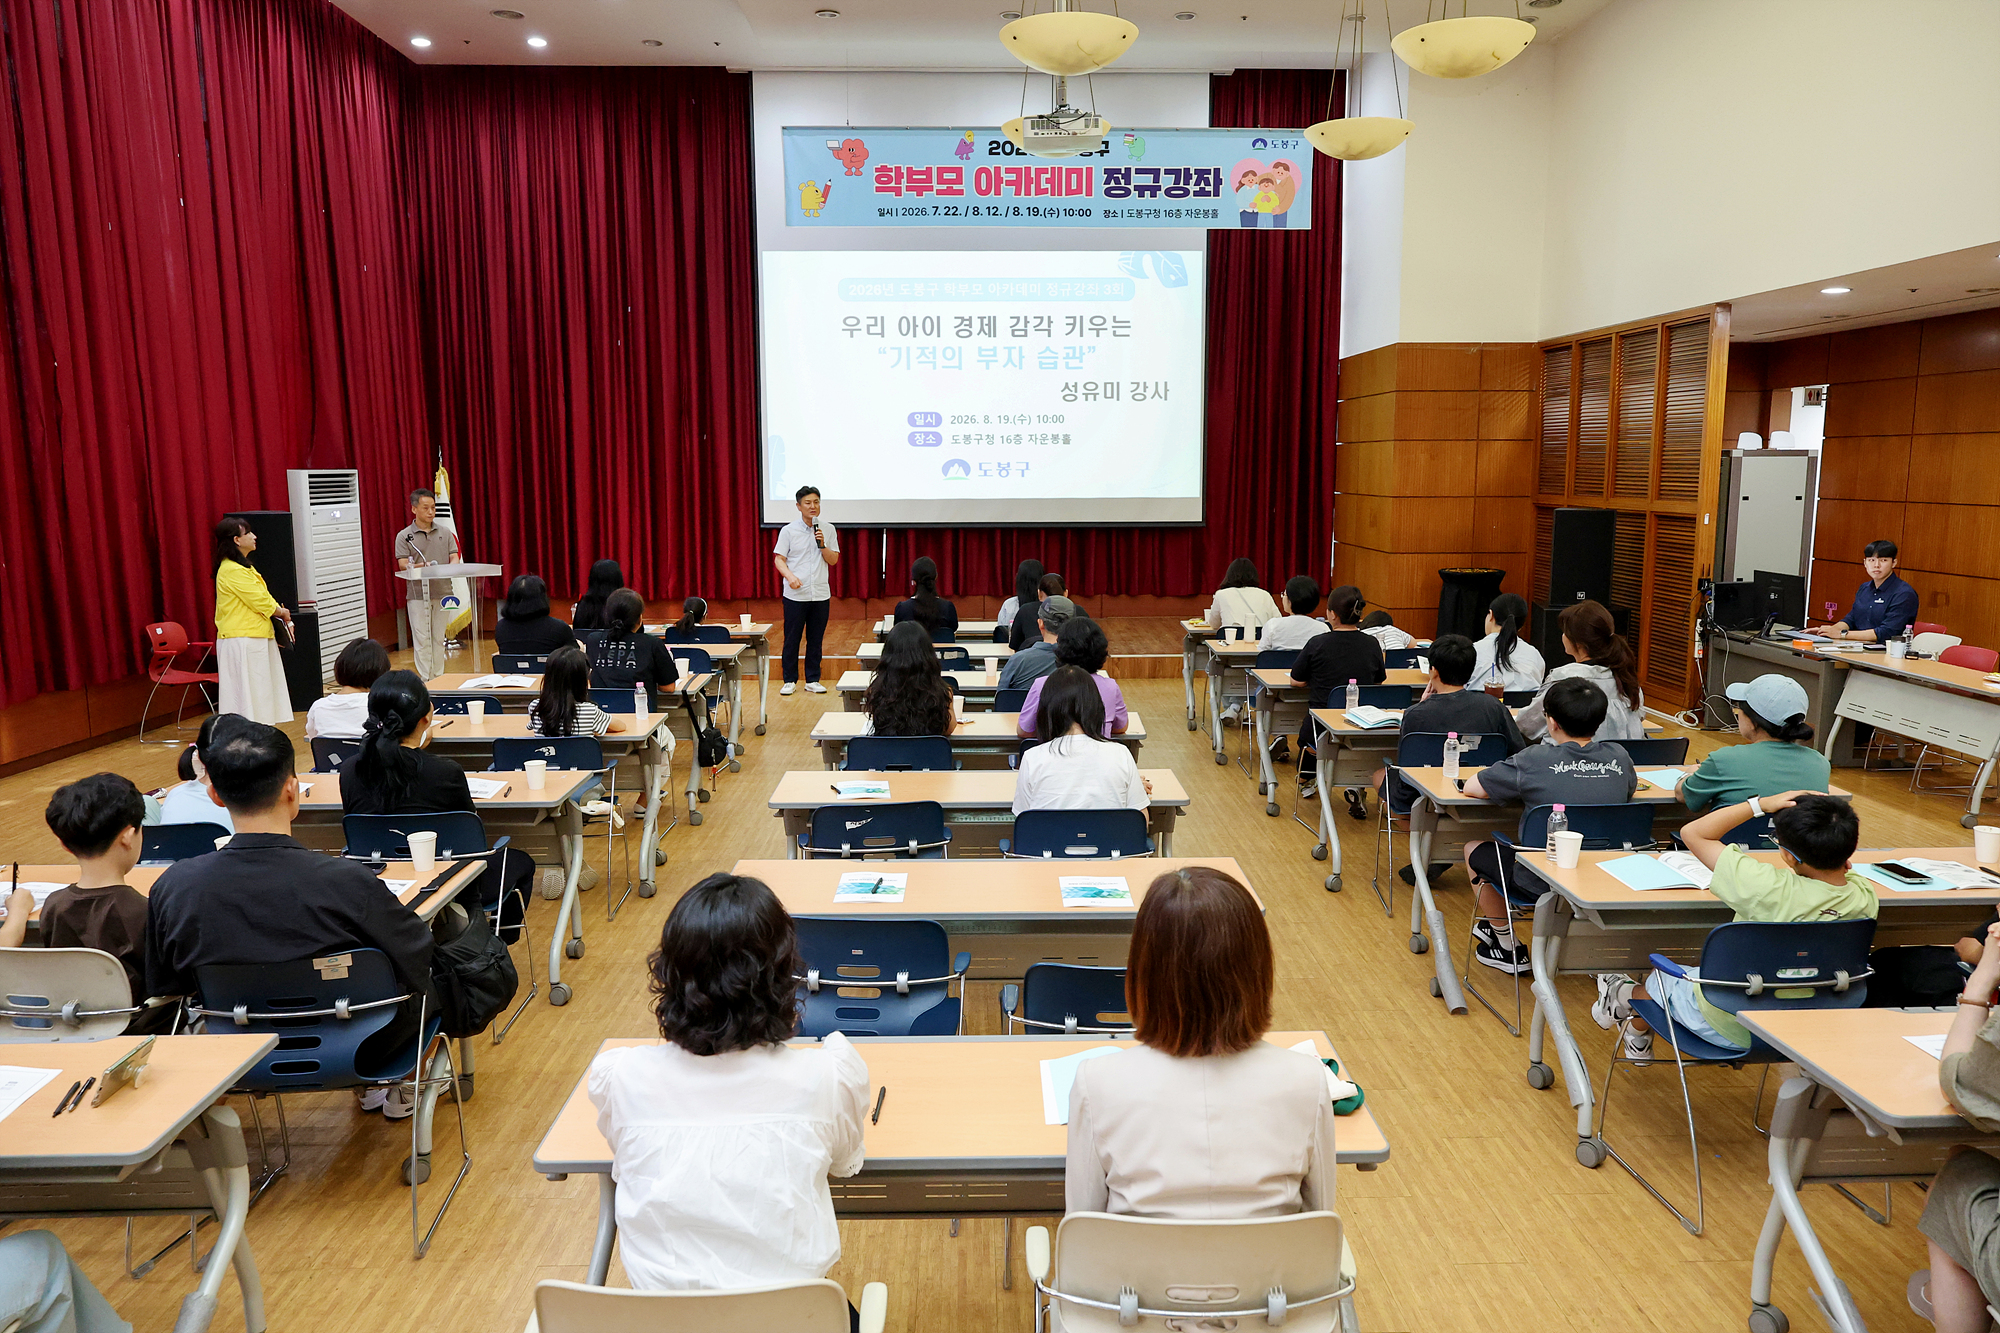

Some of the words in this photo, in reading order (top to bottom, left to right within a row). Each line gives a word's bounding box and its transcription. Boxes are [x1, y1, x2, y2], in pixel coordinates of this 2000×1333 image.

[1271, 139, 1299, 150] 도봉구
[874, 164, 965, 198] 학부모
[974, 165, 1094, 198] 아카데미
[1103, 166, 1224, 199] 정규강좌
[878, 207, 893, 217] 일시
[901, 207, 930, 217] 2026.
[932, 206, 941, 216] 7.
[943, 206, 962, 217] 22.
[972, 206, 984, 217] 8.
[986, 206, 1003, 217] 12.
[1012, 206, 1024, 217] 8.
[1026, 206, 1060, 219] 19.(수)
[1063, 207, 1092, 218] 10:00
[1103, 209, 1119, 219] 장소
[1126, 209, 1161, 219] 도봉구청
[1163, 209, 1183, 219] 16층
[1184, 209, 1219, 219] 자운봉홀
[849, 283, 894, 297] 2026년
[899, 283, 940, 297] 도봉구
[944, 283, 984, 297] 학부모
[988, 283, 1041, 297] 아카데미
[1046, 283, 1100, 297] 정규강좌
[1103, 283, 1125, 297] 3회
[842, 315, 885, 339] 우리
[897, 315, 941, 339] 아이
[953, 315, 997, 339] 경제
[1009, 315, 1054, 338] 감각
[1064, 315, 1132, 338] 키우는
[877, 345, 964, 371] “기적의
[976, 345, 1026, 371] 부자
[1037, 345, 1097, 371] 습관”
[1061, 381, 1121, 402] 성유미
[1129, 381, 1170, 402] 강사
[914, 414, 936, 426] 일시
[950, 415, 979, 425] 2026.
[983, 415, 993, 425] 8.
[997, 414, 1032, 426] 19.(수)
[1036, 414, 1065, 424] 10:00
[914, 433, 937, 445] 장소
[950, 434, 995, 445] 도봉구청
[1000, 434, 1024, 445] 16층
[1027, 433, 1072, 446] 자운봉홀
[978, 461, 1031, 479] 도봉구
